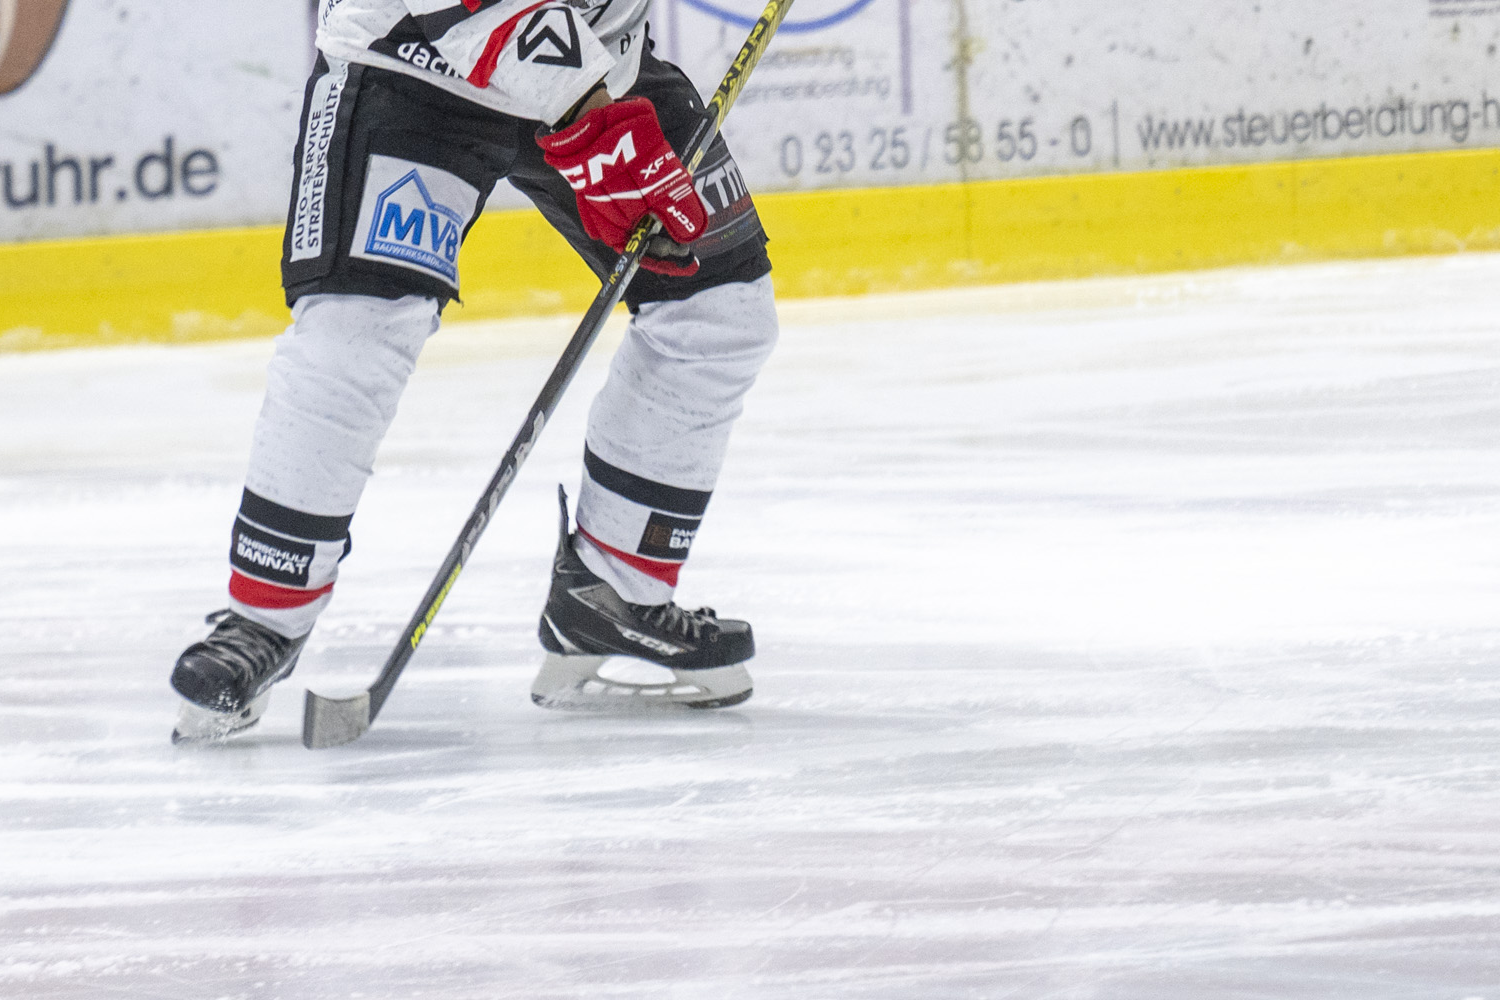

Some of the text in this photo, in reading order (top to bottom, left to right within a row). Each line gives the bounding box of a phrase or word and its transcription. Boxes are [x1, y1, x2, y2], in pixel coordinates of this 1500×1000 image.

[869, 125, 911, 171] 25
[998, 115, 1039, 161] 55
[307, 81, 339, 249] STRATENSCHULTE
[558, 130, 637, 190] CM
[640, 153, 666, 180] XF
[378, 201, 459, 264] MVB
[667, 205, 696, 234] CCM
[236, 543, 308, 576] BANNAT
[238, 532, 310, 563] FAHRSCHULE
[668, 536, 691, 550] BA
